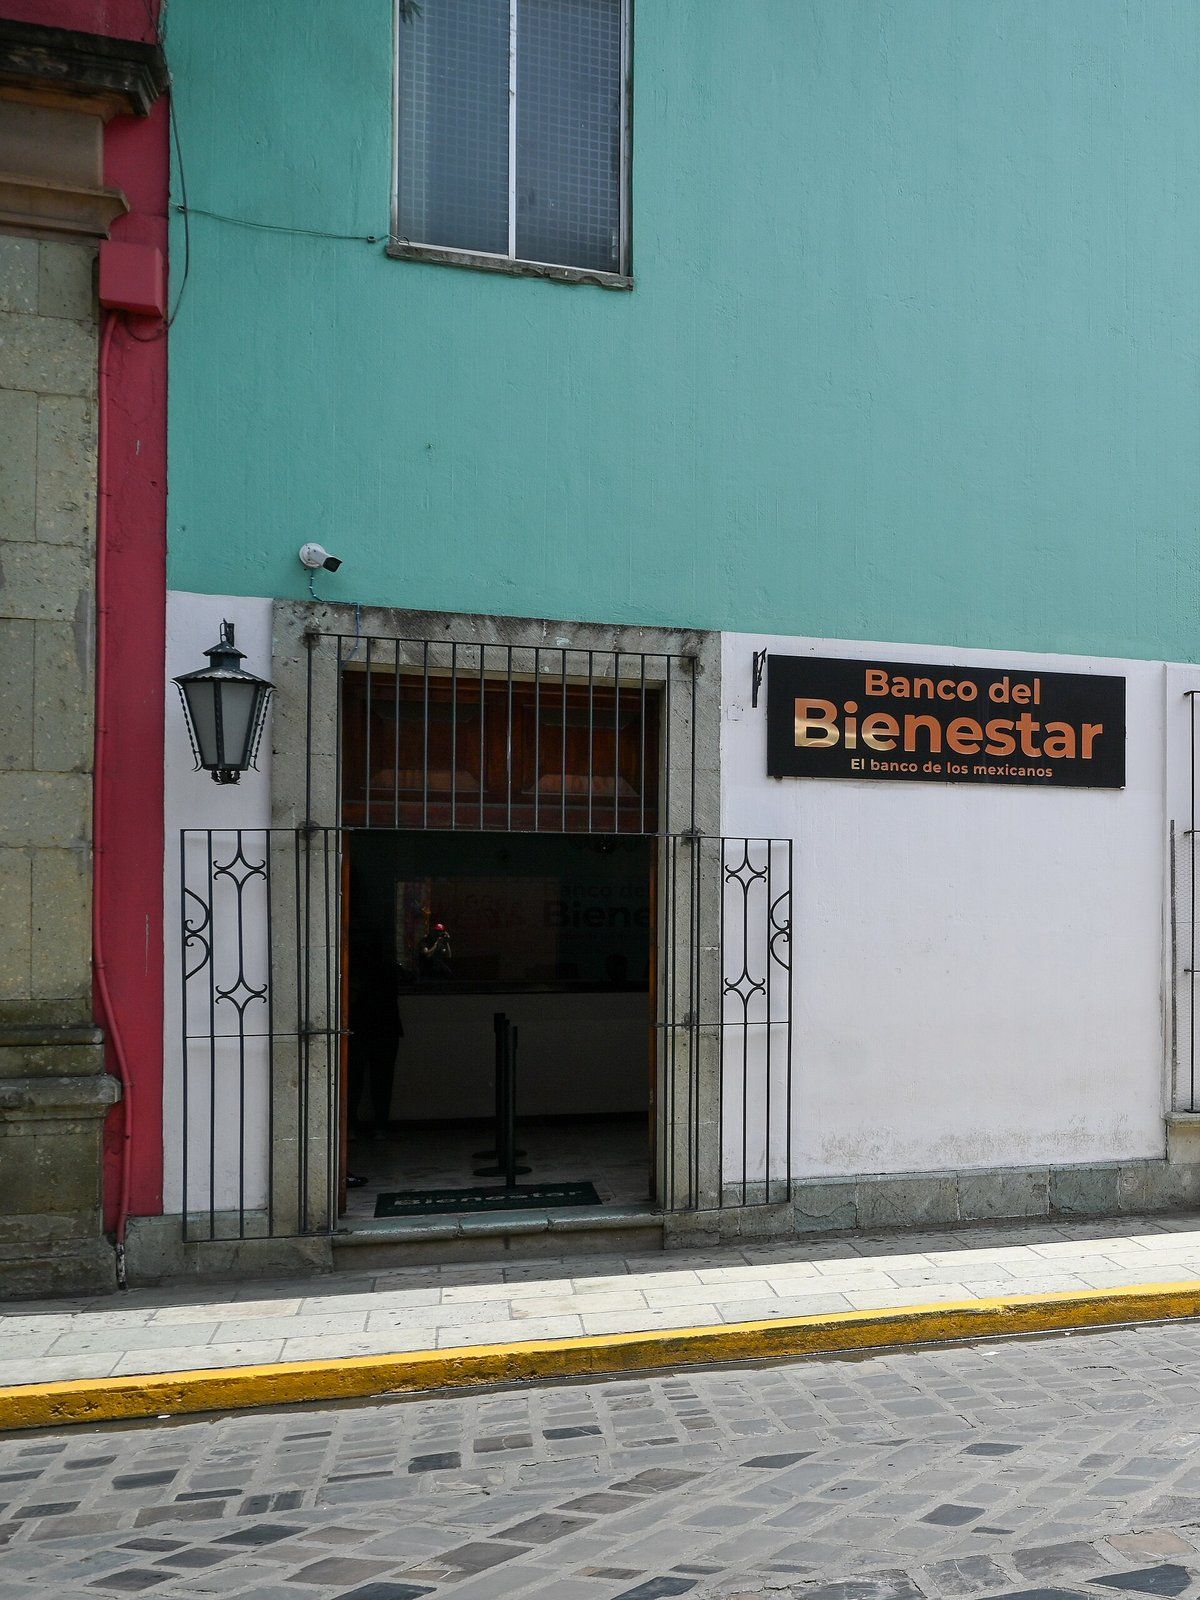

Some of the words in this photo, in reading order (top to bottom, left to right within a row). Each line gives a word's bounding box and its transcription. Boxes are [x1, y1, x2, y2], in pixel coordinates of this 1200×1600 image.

[865, 668, 978, 702] Banco
[988, 675, 1041, 705] del
[794, 697, 1103, 759] Bienestar
[850, 757, 865, 770] El
[870, 758, 919, 772] banco
[922, 760, 942, 773] de
[946, 761, 969, 774] los
[973, 763, 1053, 777] mexicanos
